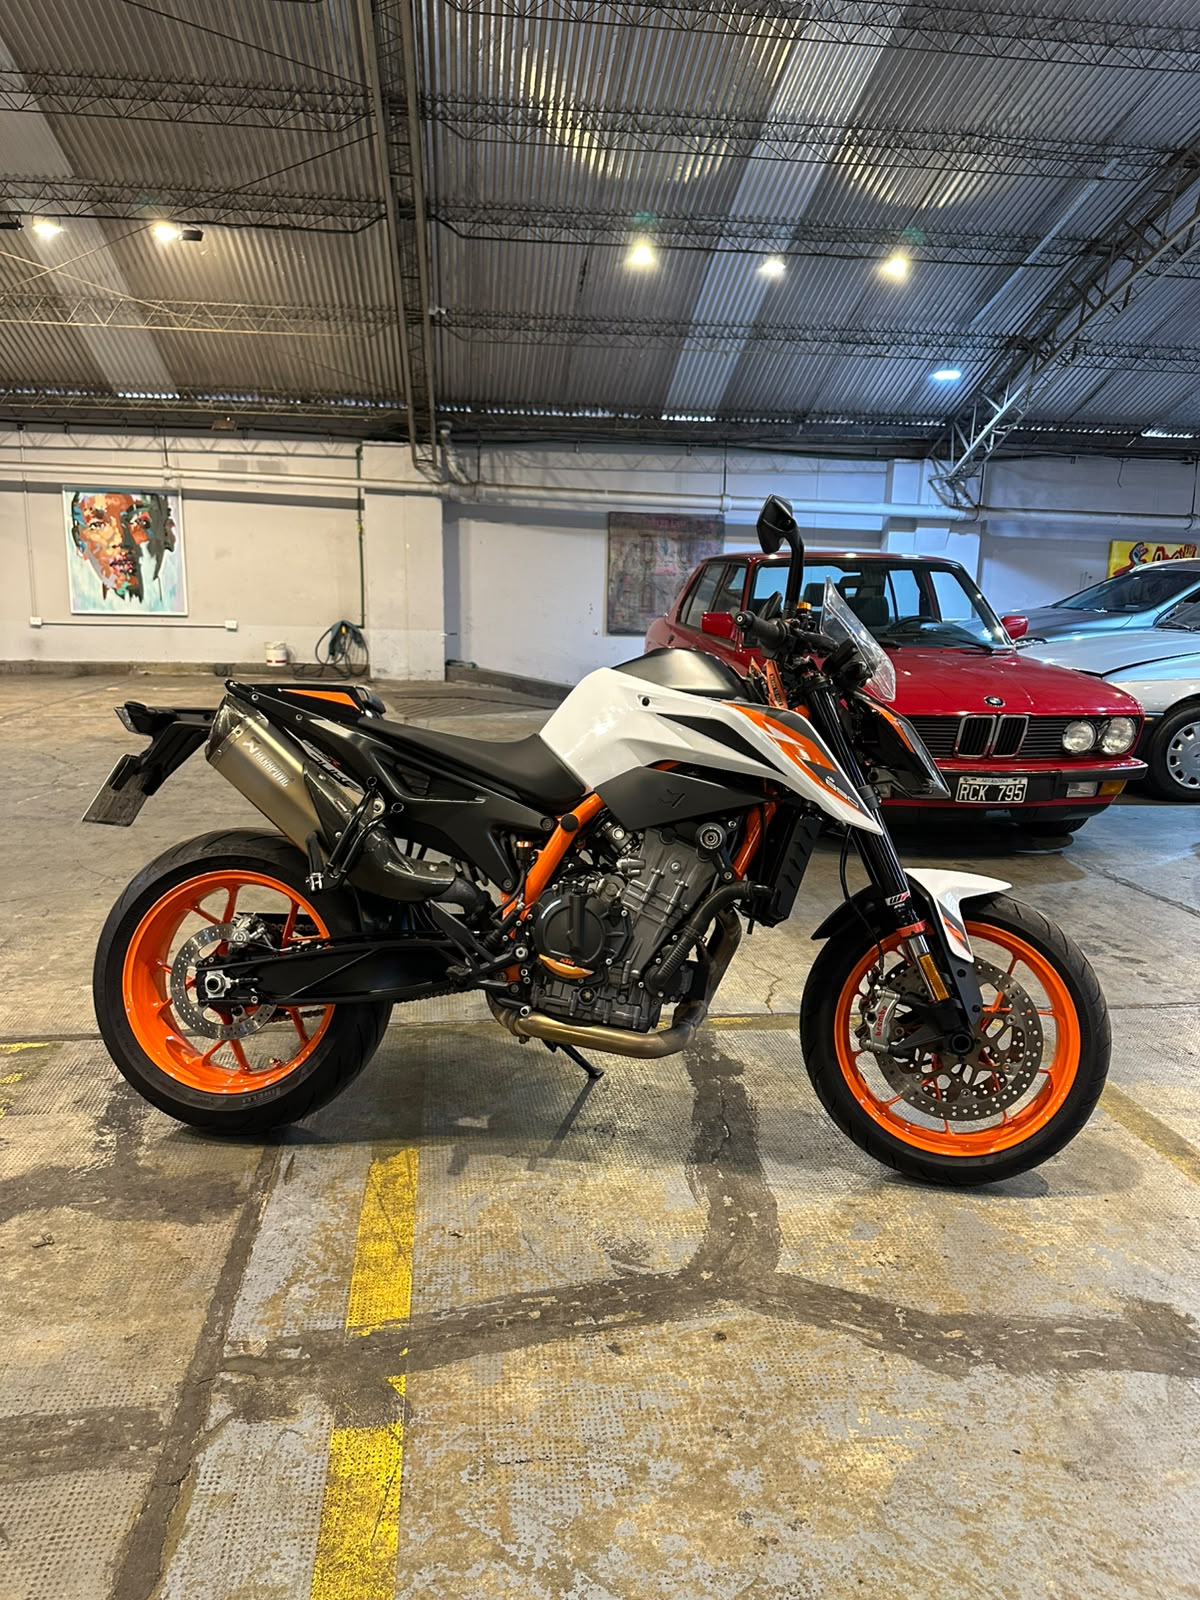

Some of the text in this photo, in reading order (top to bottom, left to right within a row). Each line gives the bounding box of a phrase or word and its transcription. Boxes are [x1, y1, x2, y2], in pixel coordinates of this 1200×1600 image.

[959, 784, 1024, 801] RCK 795
[874, 1006, 887, 1037] brembo
